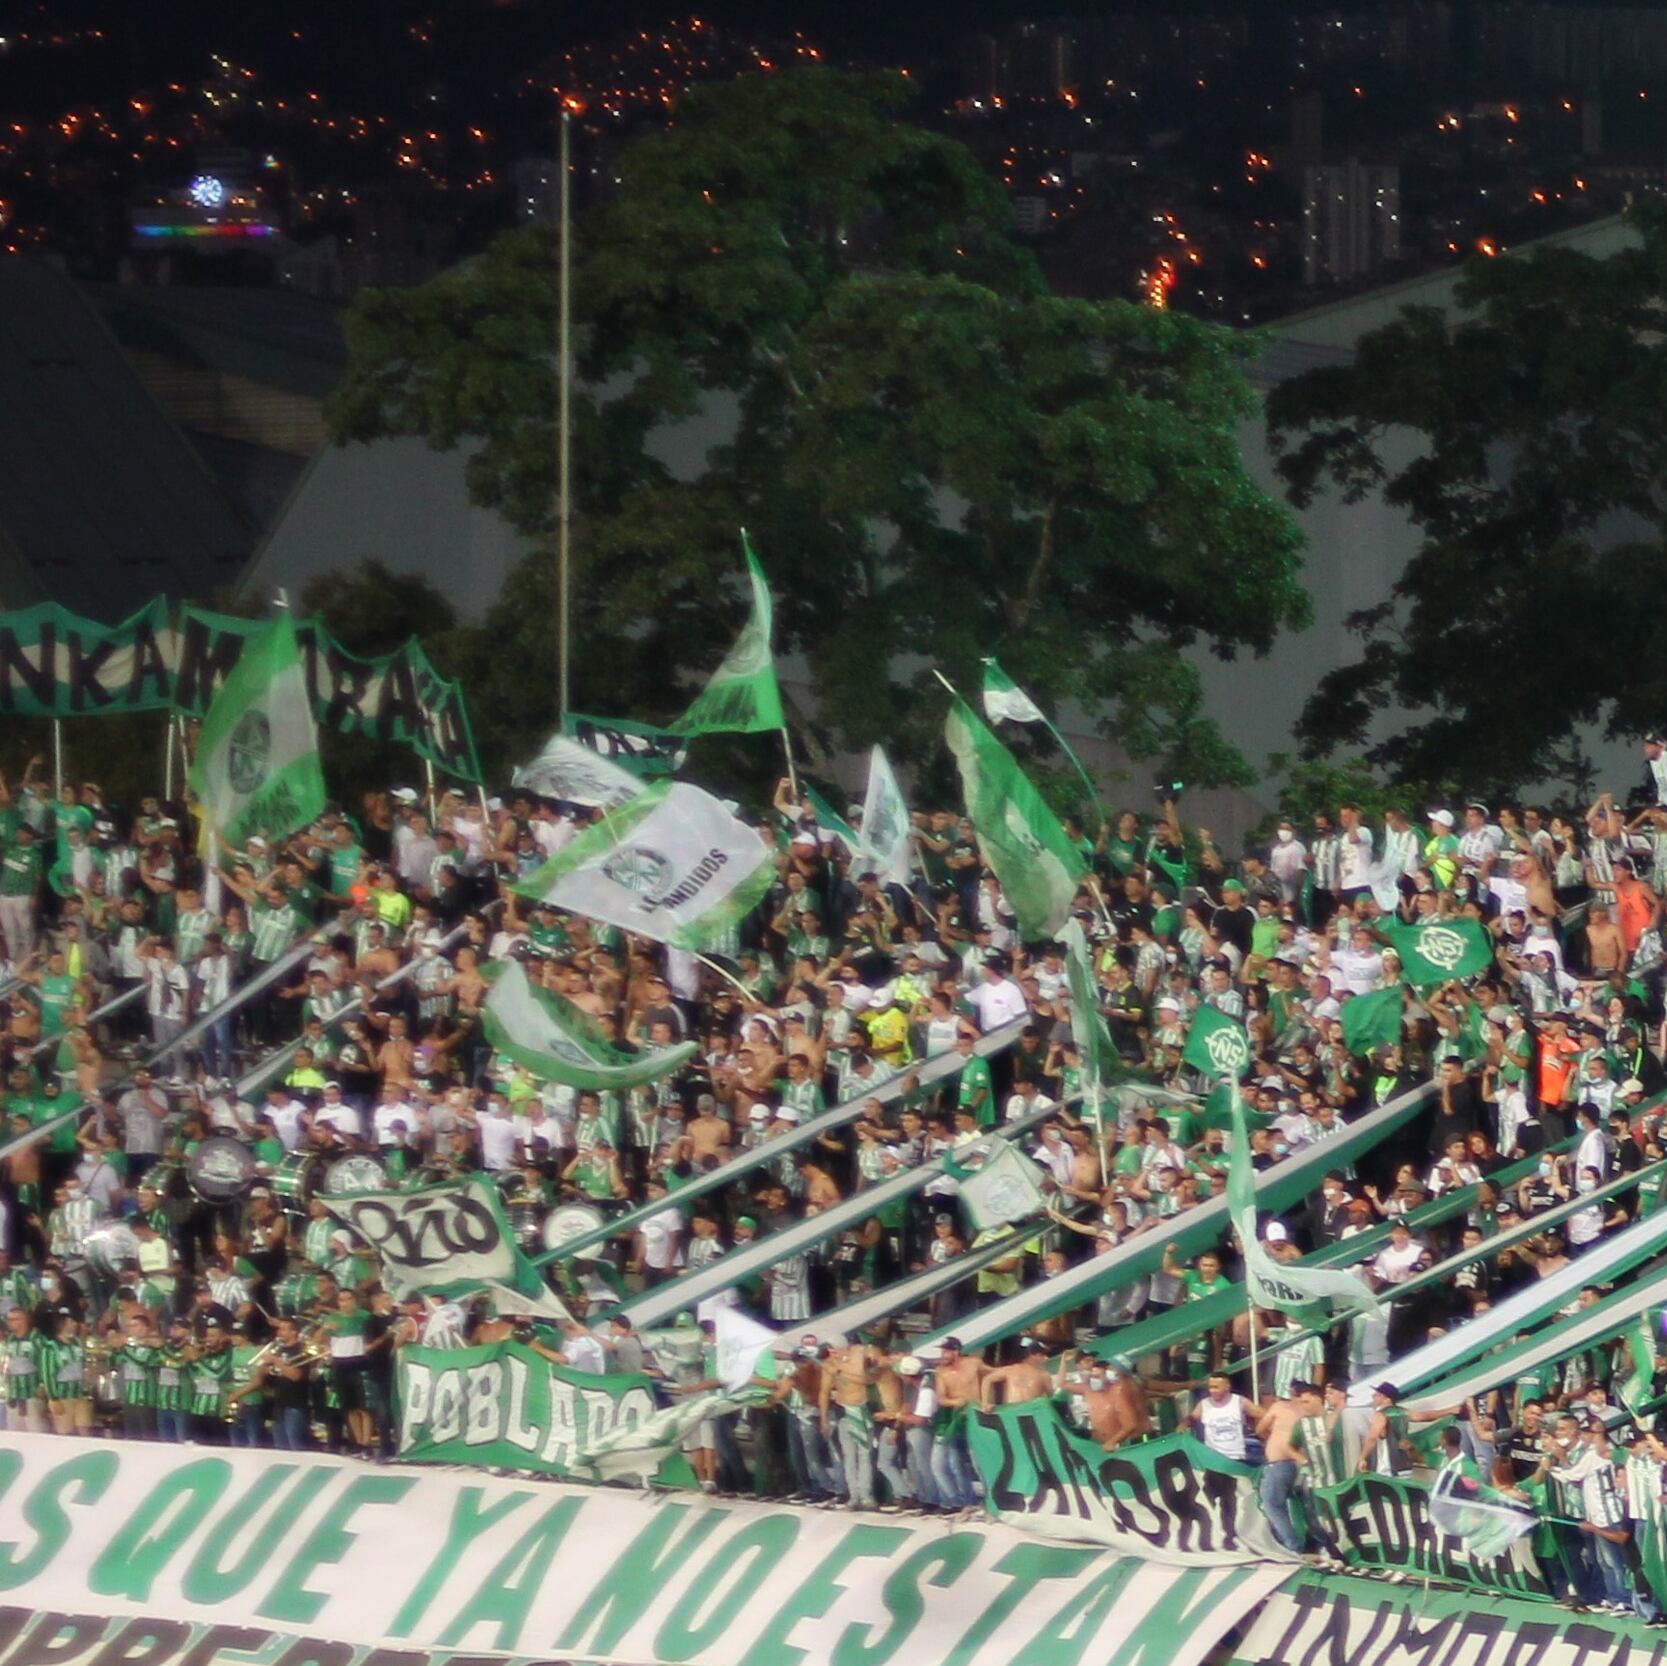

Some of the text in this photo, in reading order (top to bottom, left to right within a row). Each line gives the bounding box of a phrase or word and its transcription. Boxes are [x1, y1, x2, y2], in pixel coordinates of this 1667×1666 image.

[0, 1446, 120, 1592] S
[87, 1455, 421, 1625] QUE
[384, 1485, 589, 1650] YA
[552, 1502, 802, 1662] NO
